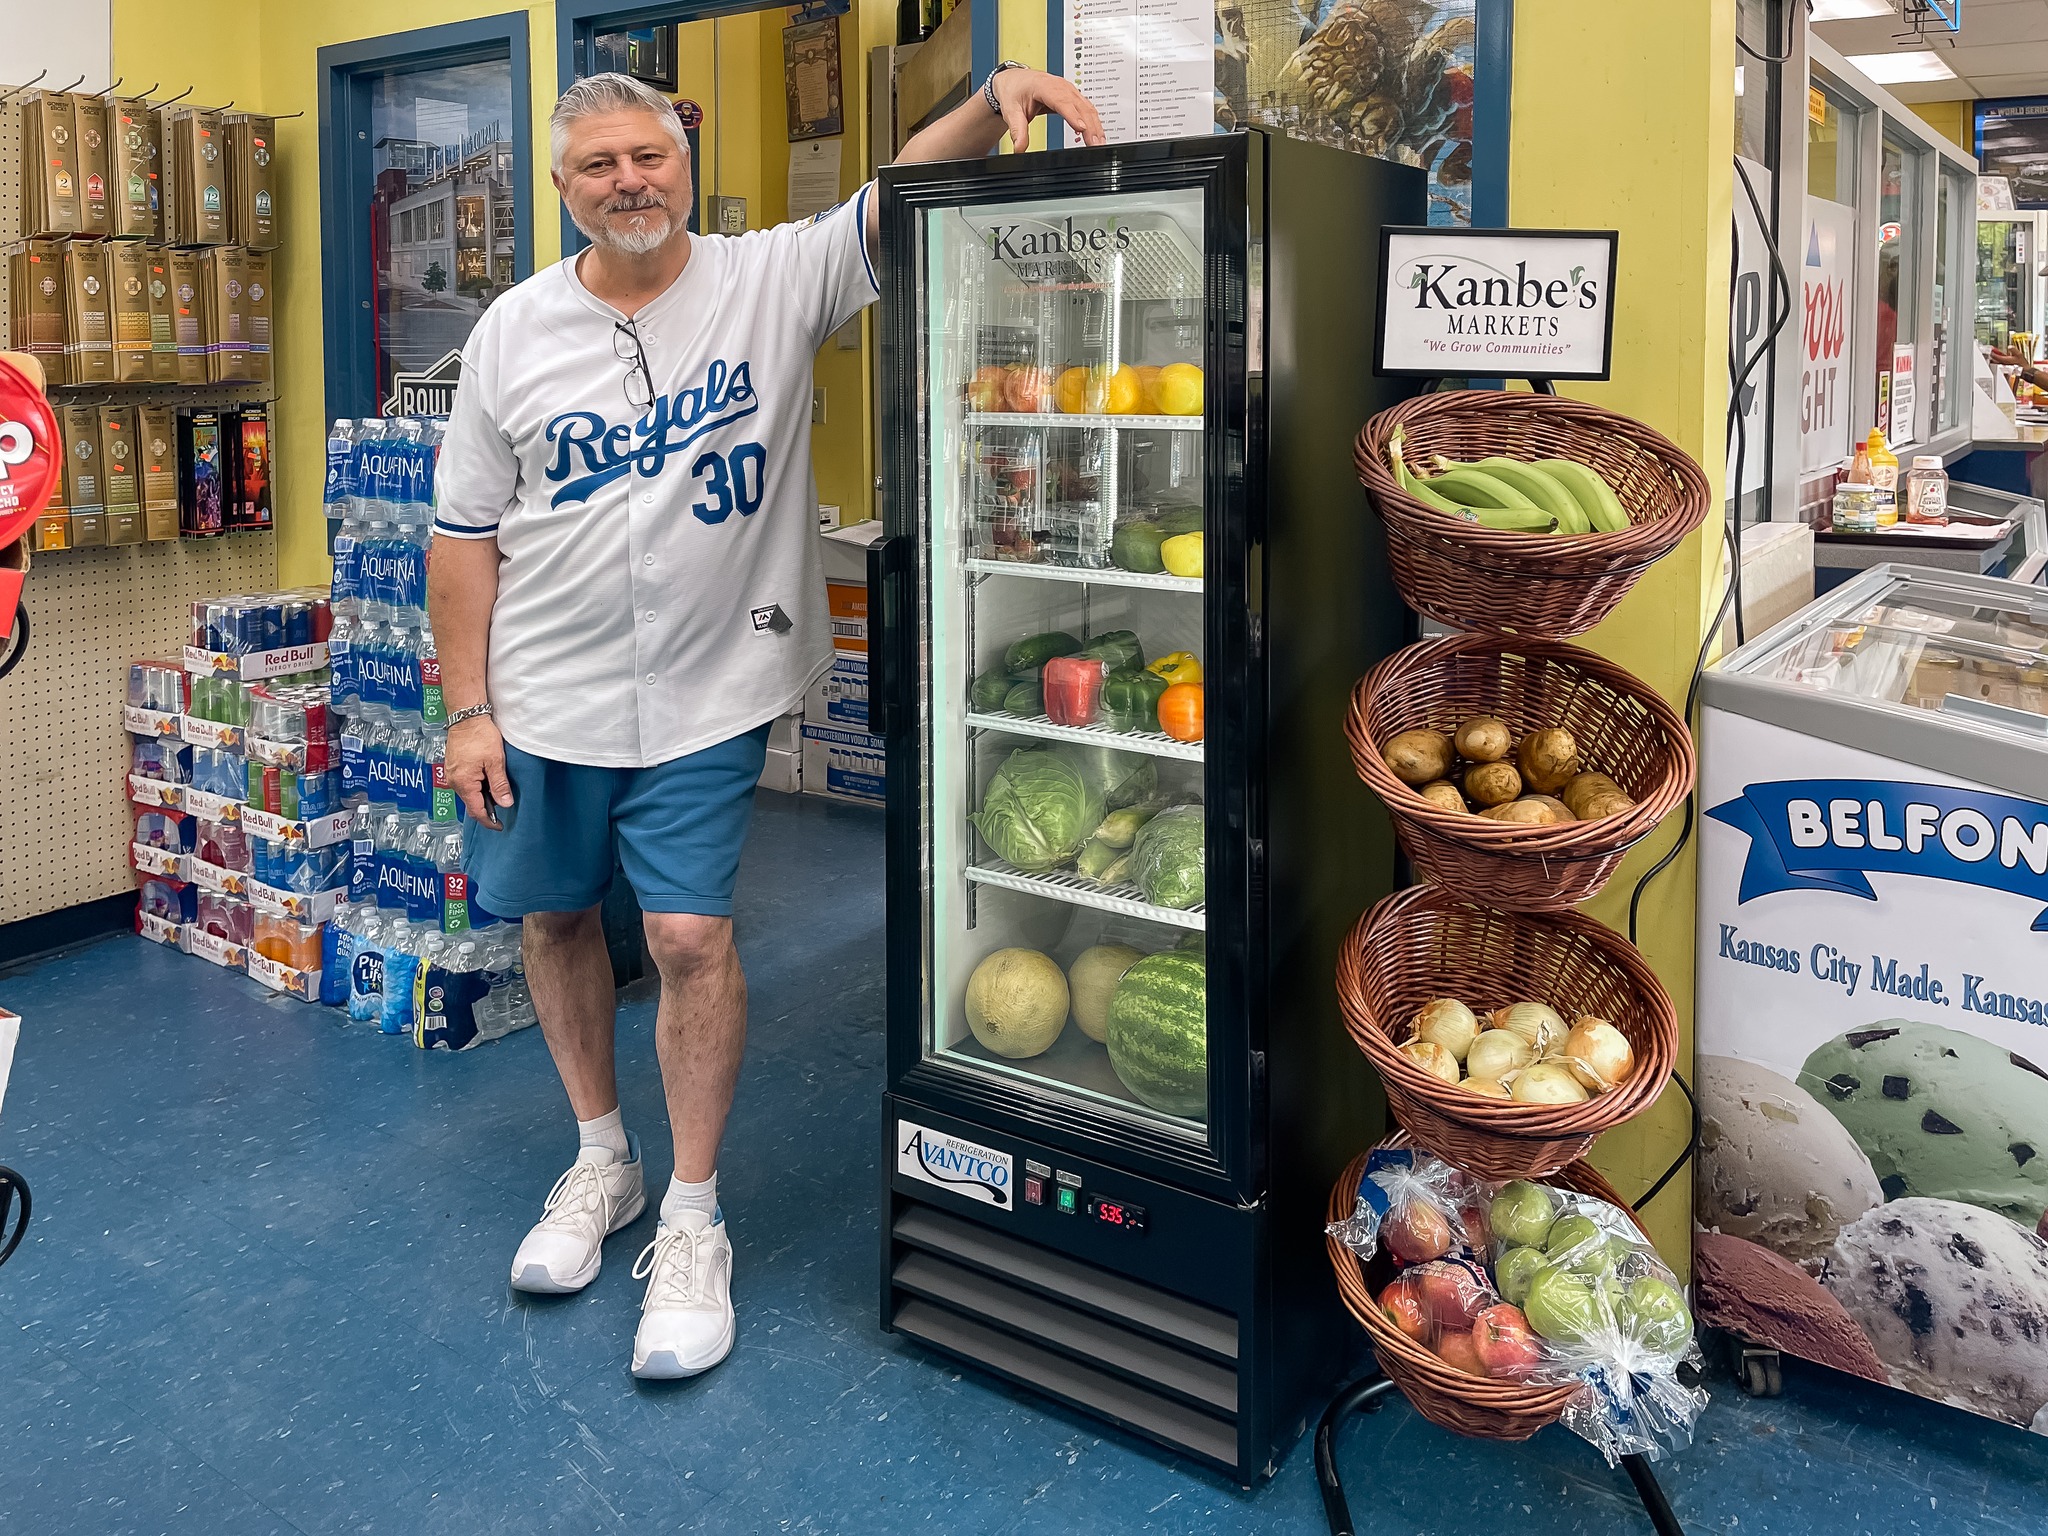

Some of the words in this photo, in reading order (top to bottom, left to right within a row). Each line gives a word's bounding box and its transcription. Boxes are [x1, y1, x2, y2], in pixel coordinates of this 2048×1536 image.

[1998, 107, 2025, 116] WORLD
[60, 178, 69, 188] 2
[91, 181, 100, 191] 4
[133, 182, 142, 193] 7
[207, 192, 219, 203] 12
[989, 216, 1131, 261] Kanbe's
[1017, 258, 1102, 278] MARKETS
[1414, 260, 1598, 310] Kanbe's
[1447, 314, 1560, 337] MARKETS
[1450, 340, 1482, 353] Grow
[544, 359, 759, 483] Royals
[360, 453, 426, 482] AQUAFINA
[691, 441, 767, 526] 30
[360, 554, 417, 585] AQUAFINA
[264, 664, 292, 673] ENERGY
[293, 660, 314, 668] DRINK
[265, 651, 289, 666] Red
[290, 647, 313, 662] Bull
[423, 662, 440, 675] 32
[806, 727, 818, 738] NEW
[818, 729, 850, 743] AMSTERDAM
[850, 733, 869, 746] VODKA
[870, 737, 885, 749] 50ML
[242, 811, 258, 825] Red
[258, 815, 273, 829] Bull
[448, 876, 464, 890] 32
[1719, 923, 1800, 974] Kansas
[1810, 943, 1862, 996] City
[1870, 955, 1950, 1007] Made.
[902, 1130, 1009, 1192] AVANTCO
[945, 1138, 1009, 1166] REFRIGERATION
